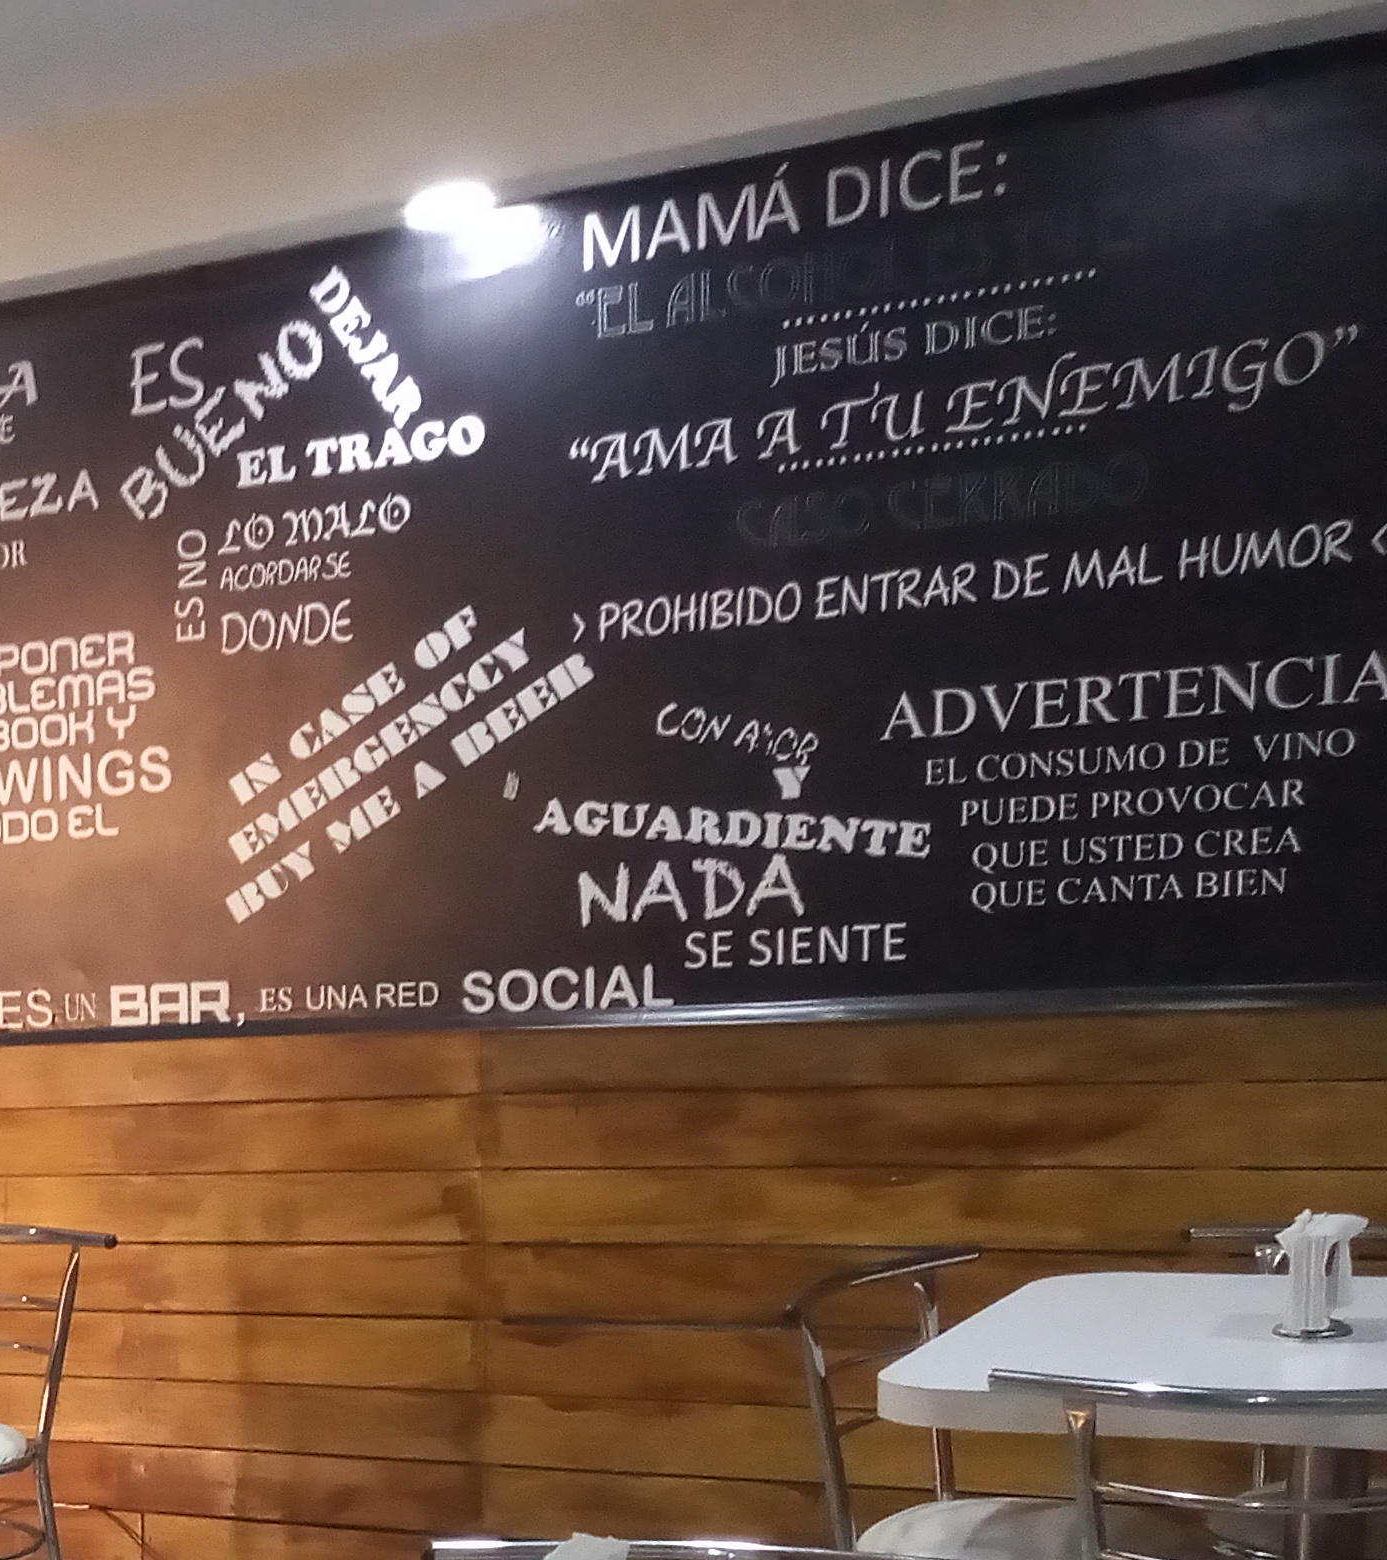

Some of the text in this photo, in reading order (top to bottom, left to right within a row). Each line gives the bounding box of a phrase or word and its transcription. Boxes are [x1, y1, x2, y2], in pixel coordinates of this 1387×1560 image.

[582, 162, 800, 272] MAMÁ
[826, 139, 1008, 229] DICE:
[130, 336, 205, 416] ES
[309, 265, 422, 429] DEJAR
[770, 304, 1058, 387] JESÚS DICE:
[120, 320, 323, 520] BUENO
[757, 407, 801, 460] A
[821, 381, 925, 451] TU
[945, 323, 1358, 433] ENEMIGO”
[236, 415, 486, 488] EL TRAGO
[218, 492, 411, 555] LO MALO
[175, 529, 208, 642] ES NO
[598, 518, 1354, 641] PROHIBIDO ENTRAR DE MAL HUMOR
[221, 598, 354, 655] DONDE
[106, 703, 137, 741] Y
[228, 604, 478, 806] IN CASE OF
[656, 701, 730, 744] CON
[879, 648, 1387, 741] ADVERTENCIA
[227, 627, 530, 865] EMERGENCY
[772, 764, 811, 800] Y
[925, 727, 1355, 785] EL CONSUMO DE VINO
[68, 803, 120, 839] EL
[225, 653, 596, 924] BUY ME A BEER
[960, 777, 1305, 827] PUEDE PROVOCAR
[532, 797, 932, 859] AGUARDIENTE
[971, 826, 1302, 874] QUE USTED CREA
[578, 853, 805, 928] NADA
[971, 867, 1288, 913] QUE CANTA BIEN
[684, 921, 907, 969] SE SIENTE
[64, 991, 96, 1022] UN
[259, 986, 293, 1013] ES
[306, 985, 368, 1012] UNA
[375, 981, 439, 1009] RED
[462, 963, 674, 1014] SOCIAL
